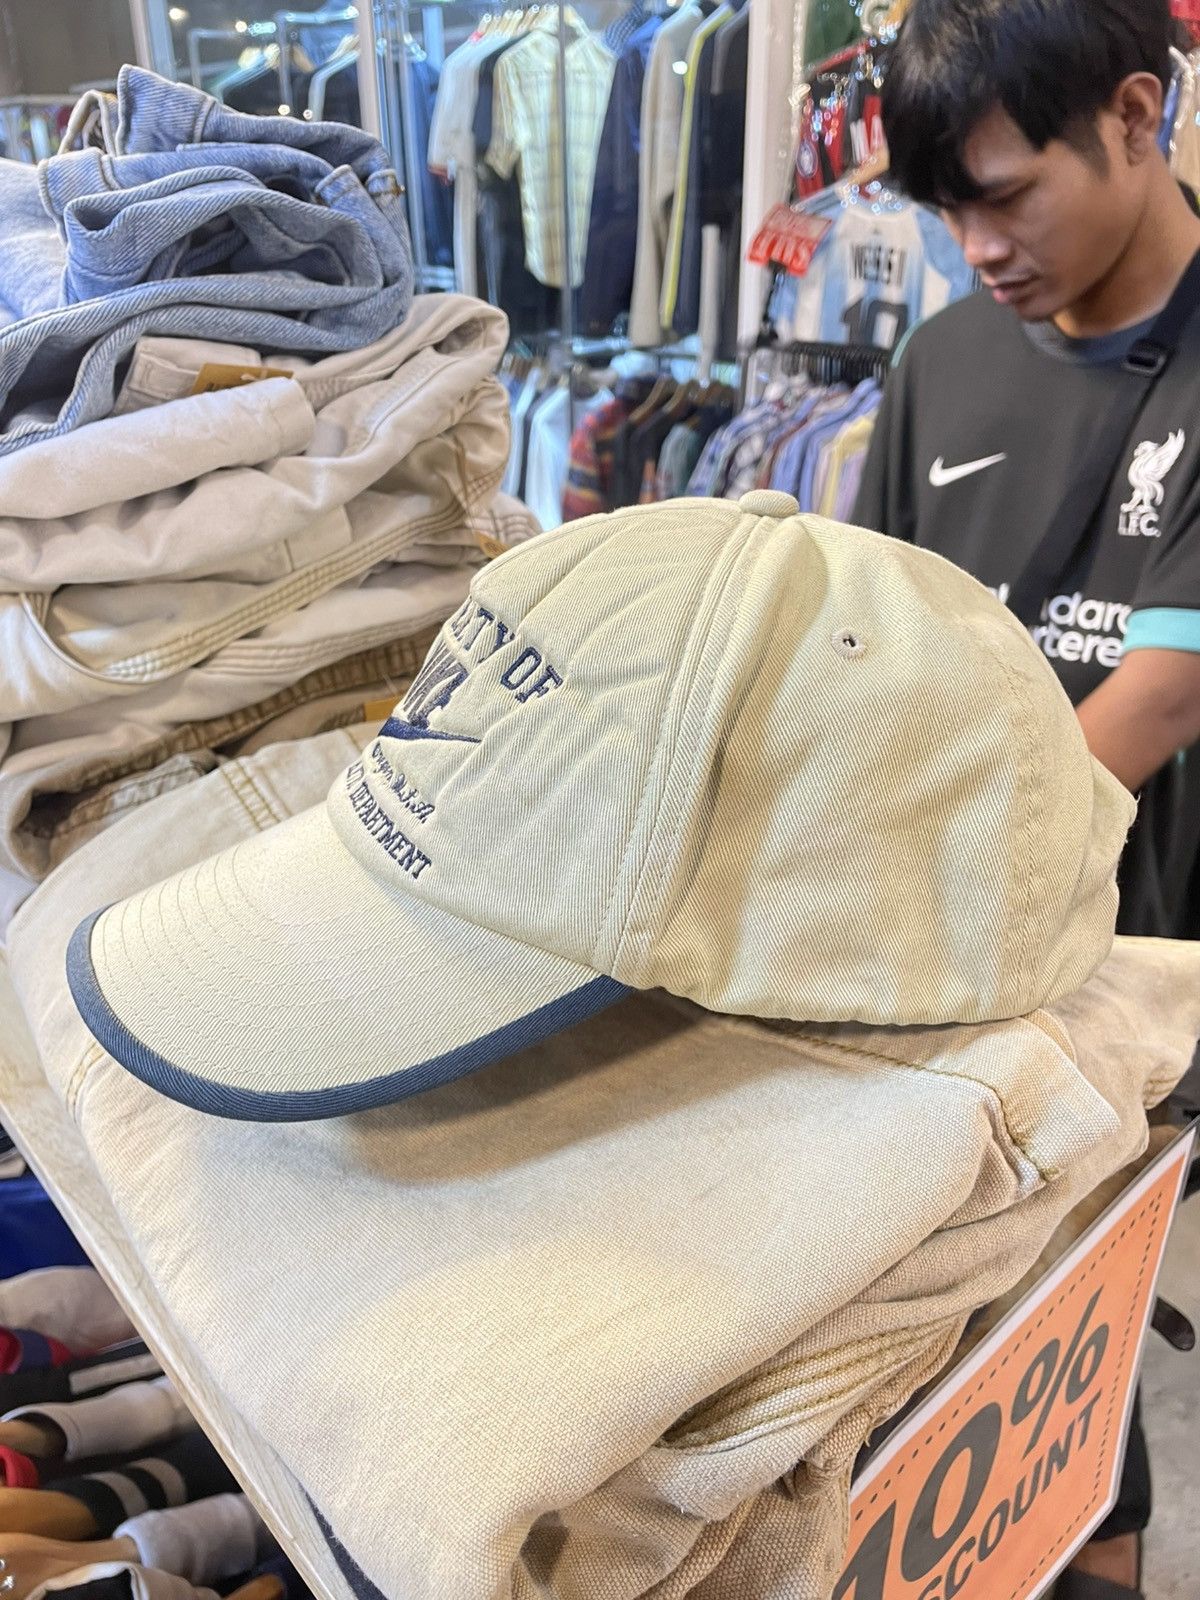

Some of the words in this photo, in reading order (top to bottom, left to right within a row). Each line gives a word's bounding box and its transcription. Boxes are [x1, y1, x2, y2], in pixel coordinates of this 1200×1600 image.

[501, 646, 563, 703] OF
[350, 781, 432, 879] DEPARTMENT
[832, 1284, 1110, 1600] 10%
